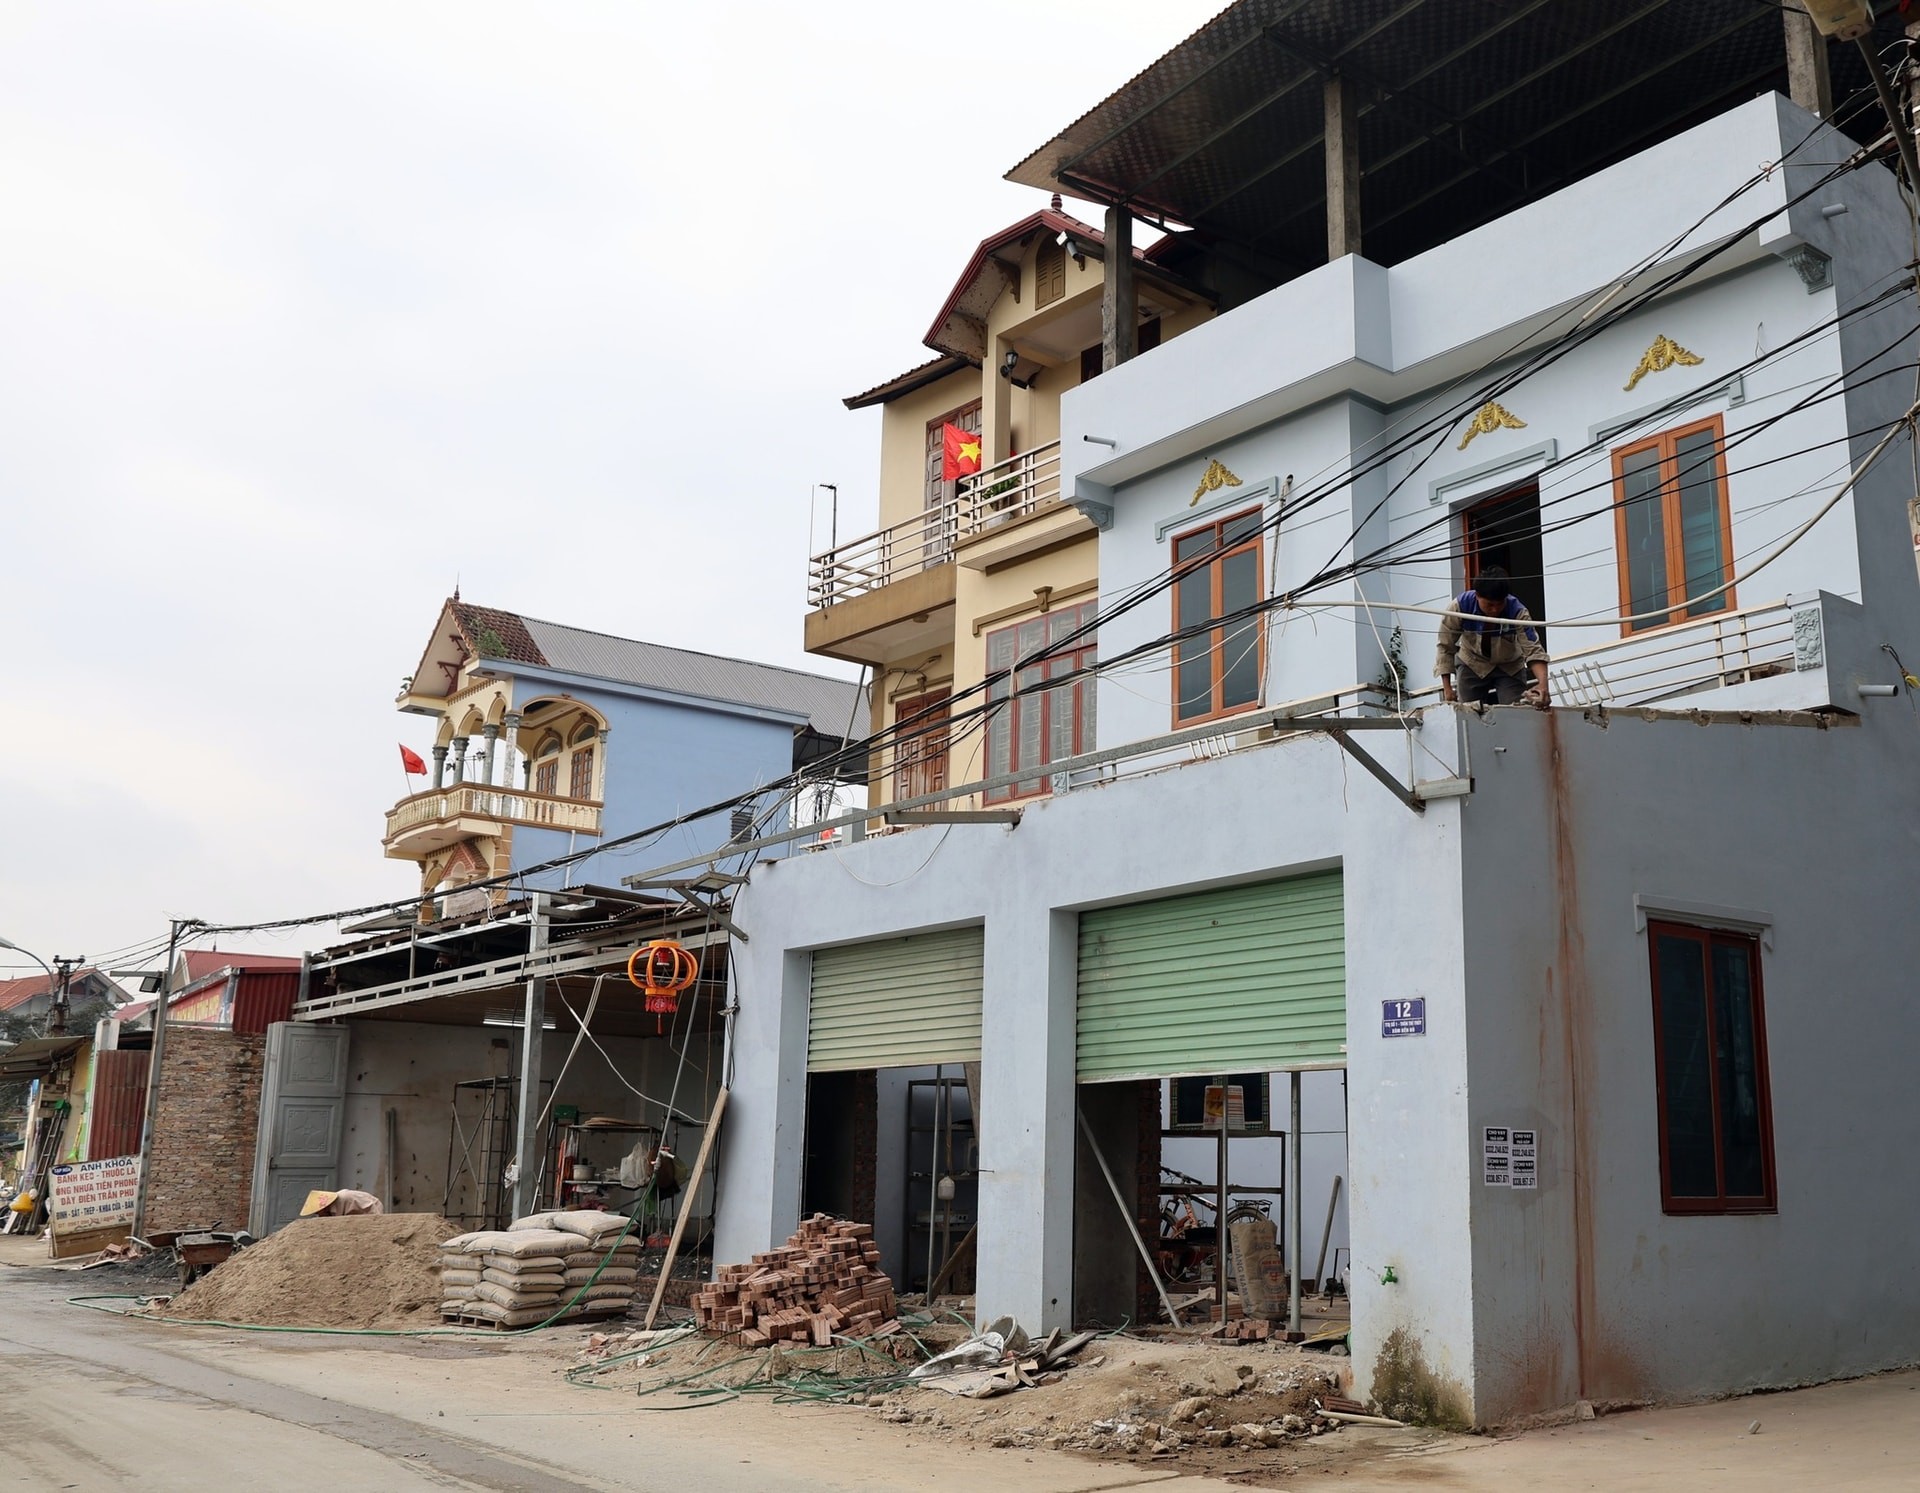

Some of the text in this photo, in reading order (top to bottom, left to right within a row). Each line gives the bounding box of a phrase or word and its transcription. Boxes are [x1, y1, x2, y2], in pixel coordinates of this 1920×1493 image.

[1395, 1002, 1411, 1018] 12
[80, 1164, 102, 1172] ANH
[1239, 1274, 1248, 1296] NAM
